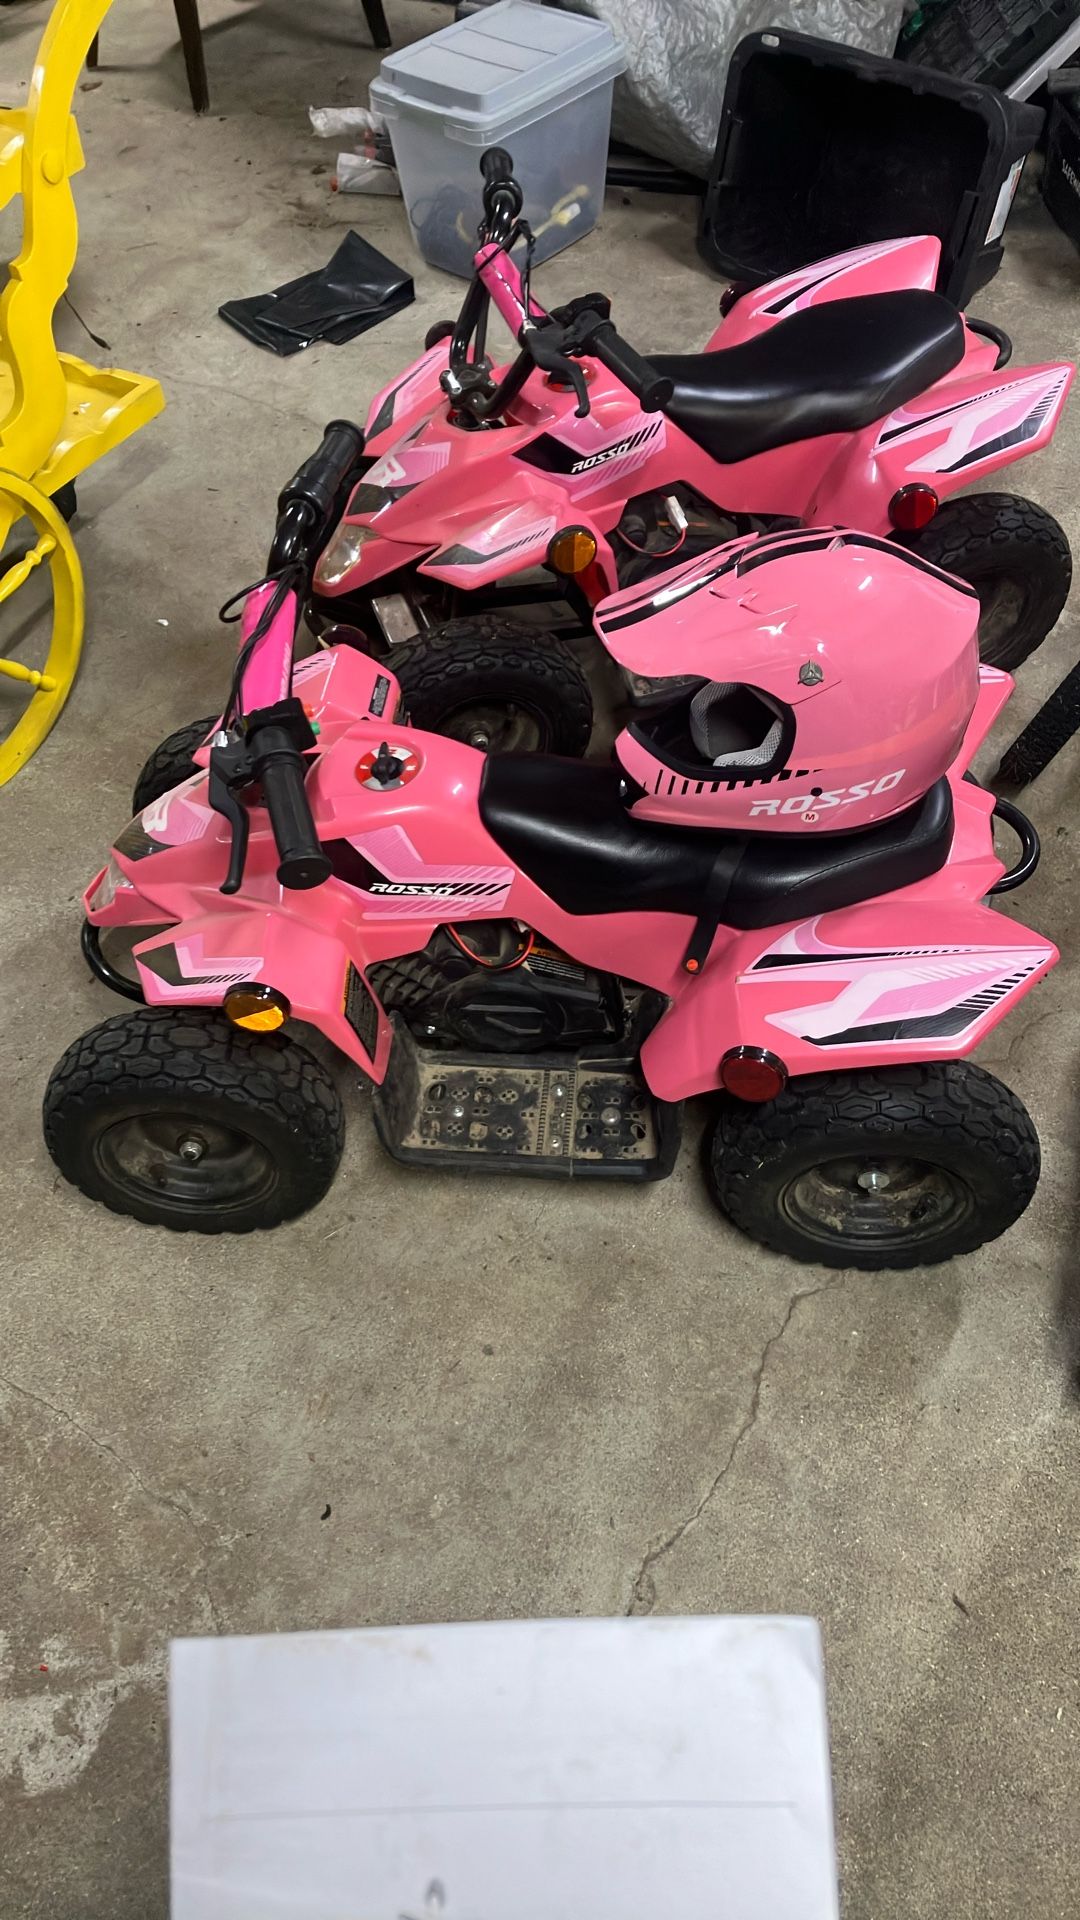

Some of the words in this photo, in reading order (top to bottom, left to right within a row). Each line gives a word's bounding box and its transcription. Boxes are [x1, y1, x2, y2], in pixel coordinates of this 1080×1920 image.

[571, 443, 630, 473] ROSSO
[749, 769, 906, 816] ROSSO
[804, 812, 816, 822] M
[369, 883, 455, 896] ROSSO
